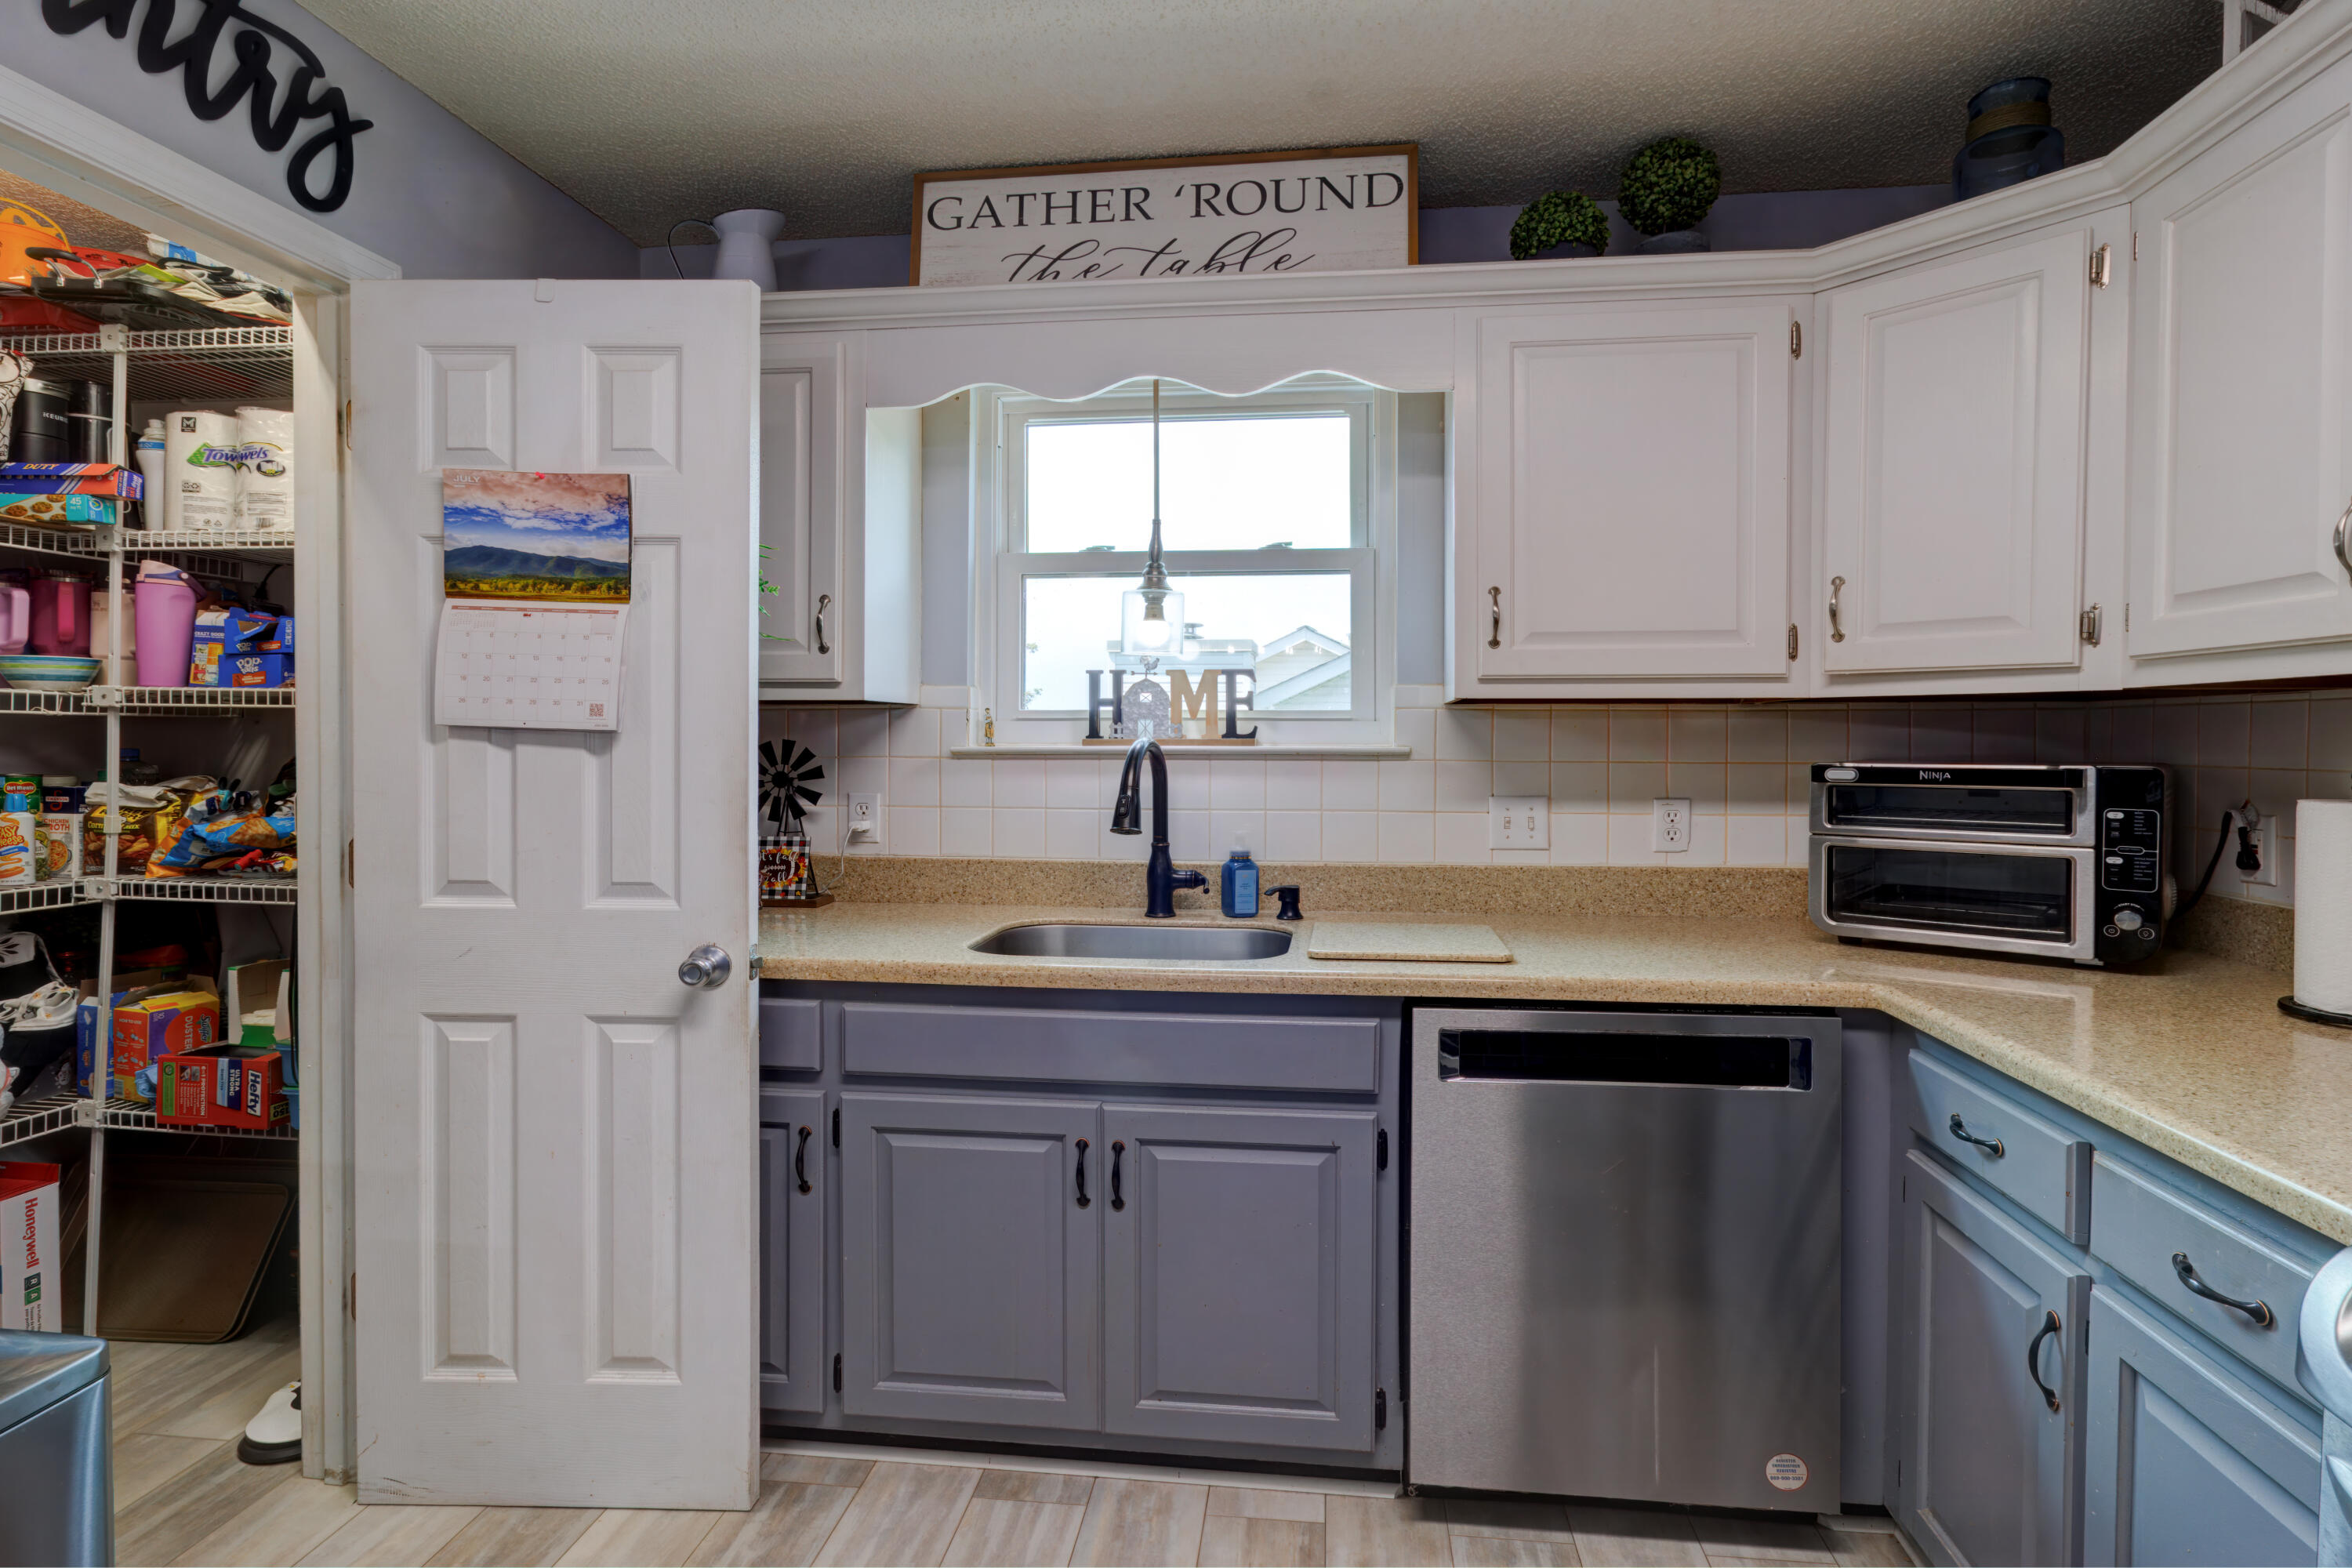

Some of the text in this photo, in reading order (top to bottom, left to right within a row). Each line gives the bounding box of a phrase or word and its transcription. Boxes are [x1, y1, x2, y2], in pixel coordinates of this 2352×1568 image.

[927, 186, 1155, 230] GATHER
[1001, 227, 1316, 282] the table
[453, 474, 481, 483] JULY
[1085, 669, 1258, 739] HME
[1919, 770, 1951, 782] NINJA
[0, 826, 17, 837] ASY
[199, 1014, 211, 1043] Swiffer
[248, 1073, 260, 1114] Hefty
[23, 1196, 40, 1269] Honeywell
